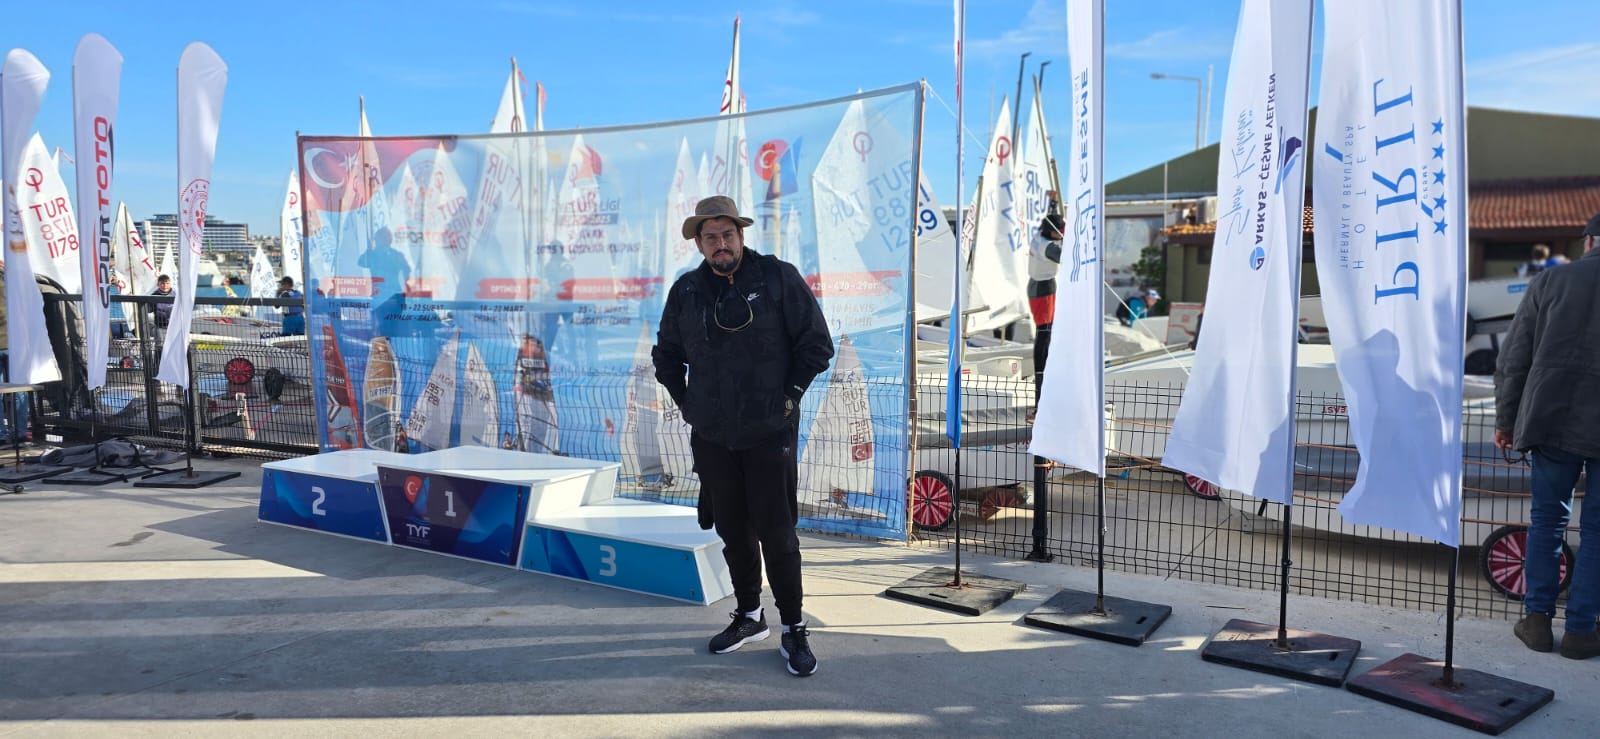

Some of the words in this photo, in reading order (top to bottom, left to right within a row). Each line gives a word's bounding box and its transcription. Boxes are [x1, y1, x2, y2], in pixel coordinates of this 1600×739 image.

[29, 197, 69, 222] TUR
[48, 234, 80, 259] 1178
[311, 486, 327, 516] 2
[444, 491, 457, 518] 1
[405, 522, 431, 539] TYF
[599, 545, 617, 577] 3
